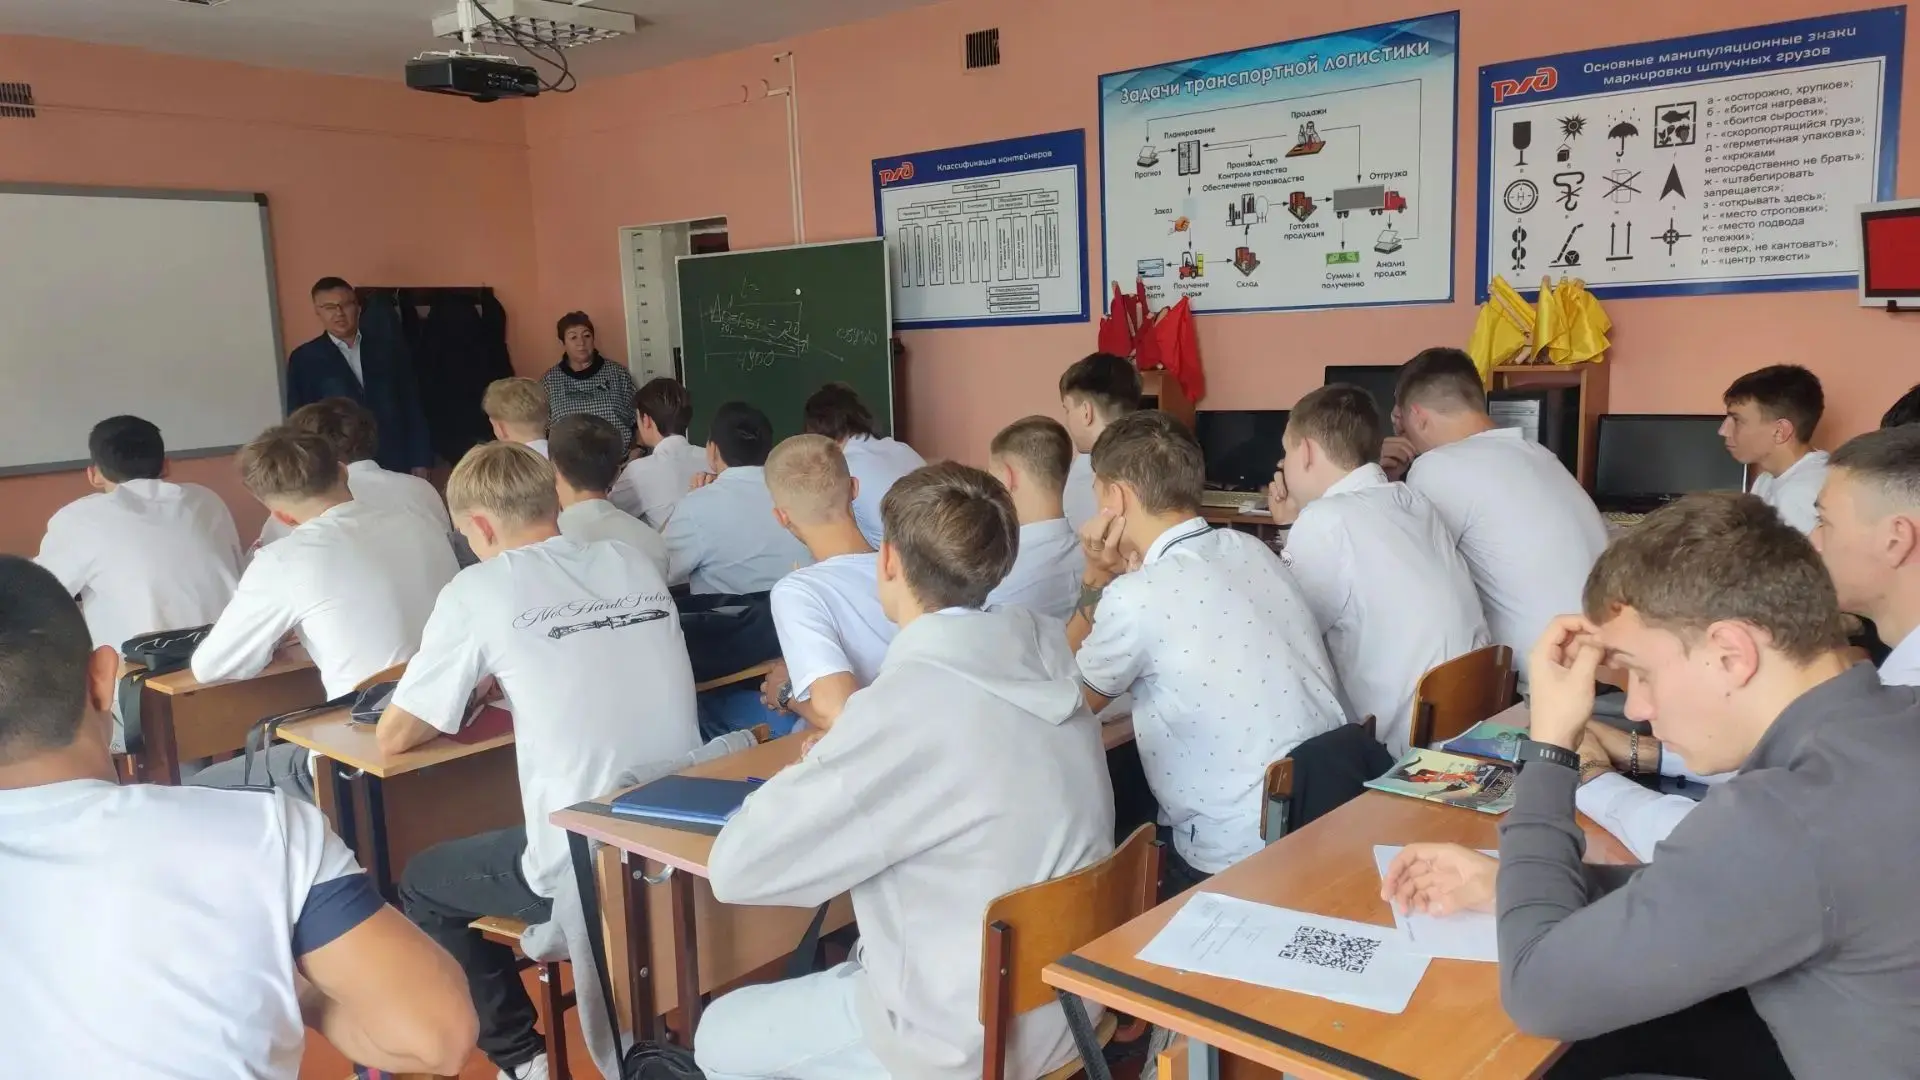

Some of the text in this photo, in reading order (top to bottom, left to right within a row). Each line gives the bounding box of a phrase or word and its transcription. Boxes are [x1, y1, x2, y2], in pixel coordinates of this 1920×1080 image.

[1583, 26, 1856, 75] Основные манипуляционные знаки
[1603, 44, 1831, 85] маркировки штучных грузов
[1121, 40, 1430, 104] Задачи транспортной логистики
[1725, 88, 1792, 102] «осторожно,
[1796, 80, 1853, 95] хрупкое»;
[1707, 108, 1713, 116] б
[1724, 102, 1768, 114] «боится
[1772, 96, 1827, 110] нагрева»;
[1291, 108, 1327, 119] Продажи
[1723, 114, 1767, 127] «боится
[1770, 108, 1828, 123] сырости»;
[1164, 126, 1215, 139] Планирование
[1721, 119, 1826, 139] «скоропортящийся
[1830, 115, 1865, 127] груз»;
[1723, 134, 1798, 150] «герметичная
[1802, 128, 1865, 143] упаковка»;
[937, 151, 1053, 172] Классификация контейнеров
[1722, 149, 1775, 162] «крюками
[1227, 158, 1278, 169] Производство
[1705, 153, 1865, 175] непосредственно не брать»;
[1135, 170, 1161, 179] Прогноз
[1218, 167, 1287, 180] Контроль качества
[1369, 170, 1407, 181] Отгрузка
[1722, 169, 1814, 185] «штабелировать
[1203, 174, 1304, 193] Обеспечение производства
[1704, 184, 1784, 198] запрещается»;
[1719, 196, 1780, 208] «открывать
[1720, 208, 1757, 219] «место
[1289, 223, 1319, 231] Готовая
[1718, 220, 1755, 230] «место
[1759, 218, 1805, 229] подвода
[1284, 231, 1325, 240] продукция
[1755, 243, 1768, 251] не
[1376, 260, 1405, 268] Анализ
[1719, 256, 1755, 265] «центр
[1760, 253, 1810, 262] тяжести»
[1326, 272, 1354, 281] Суммы
[1374, 270, 1406, 278] продаж
[1236, 280, 1258, 288] Склад
[1322, 281, 1365, 289] получению
